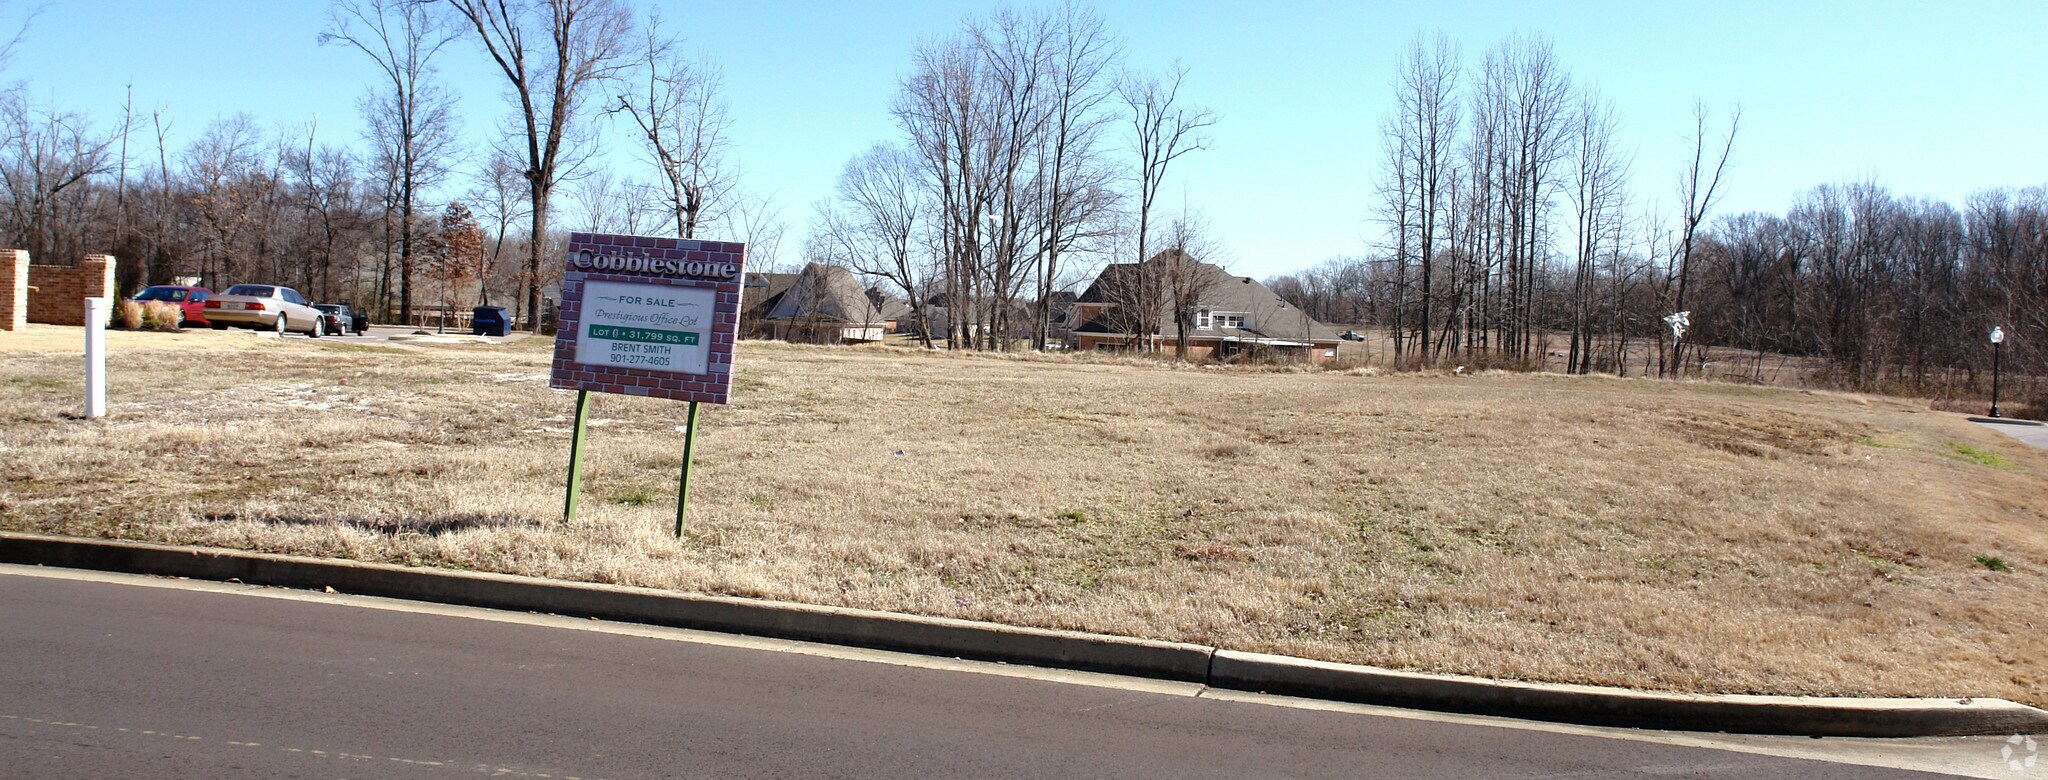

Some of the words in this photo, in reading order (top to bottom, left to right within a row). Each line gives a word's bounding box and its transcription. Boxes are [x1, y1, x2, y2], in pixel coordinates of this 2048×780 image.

[573, 248, 737, 278] Cobblestone
[619, 295, 642, 305] FOR
[646, 298, 676, 308] SALE
[595, 308, 648, 322] Prestigious
[649, 313, 679, 326] Office
[679, 315, 699, 328] Lot
[593, 329, 609, 337] LOT
[629, 331, 663, 342] 31,799
[666, 335, 681, 343] SQ.
[684, 336, 696, 344] FT
[611, 342, 641, 353] BRENT
[643, 345, 671, 355] SMITH
[610, 353, 670, 367] 901-277-4605
